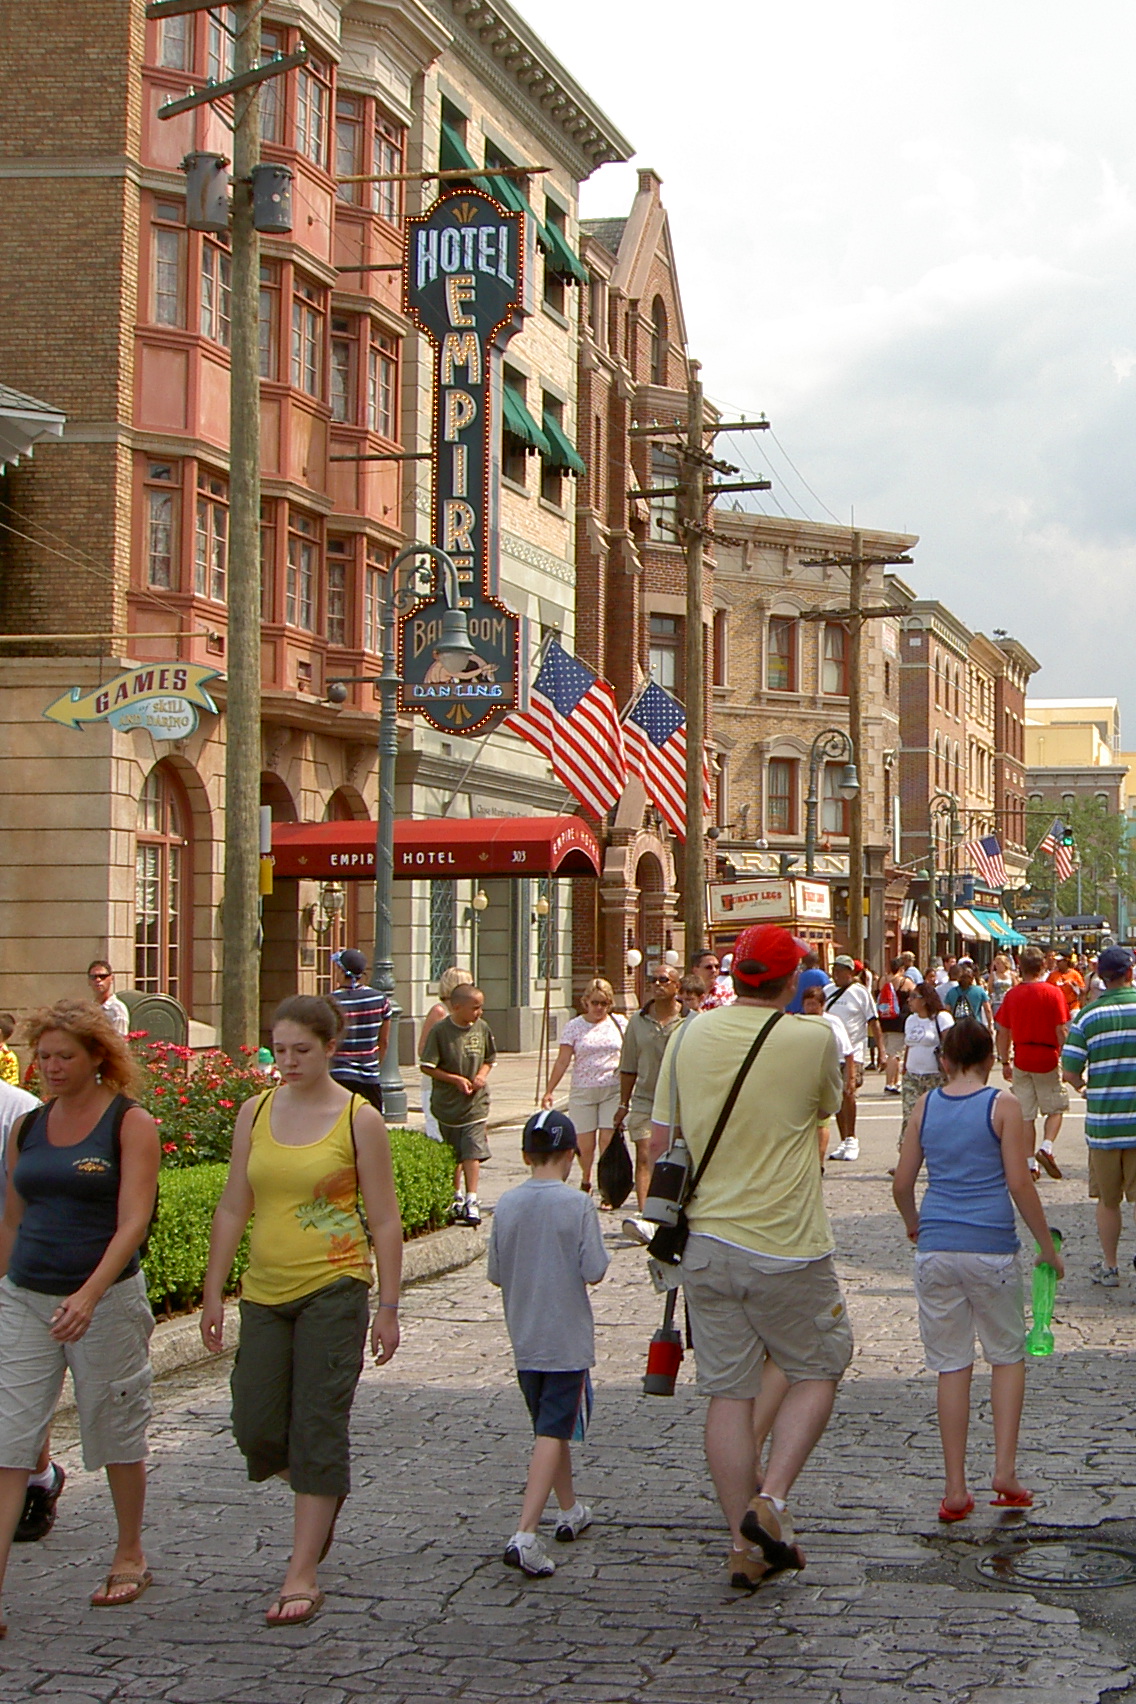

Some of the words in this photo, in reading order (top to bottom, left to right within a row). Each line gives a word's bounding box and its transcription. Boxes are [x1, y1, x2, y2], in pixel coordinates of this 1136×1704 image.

[416, 225, 515, 291] HOTEL
[440, 274, 482, 609] EMPIRE
[413, 617, 507, 658] BALOOM
[95, 668, 188, 715] GAMES
[413, 684, 503, 698] DANCING
[553, 827, 575, 855] EMPIRE
[331, 853, 375, 866] EMPIR
[403, 851, 455, 864] HOTEL
[511, 850, 527, 863] 303
[720, 893, 758, 911] TURKEY
[761, 891, 783, 900] LEGS
[551, 1126, 563, 1147] 7
